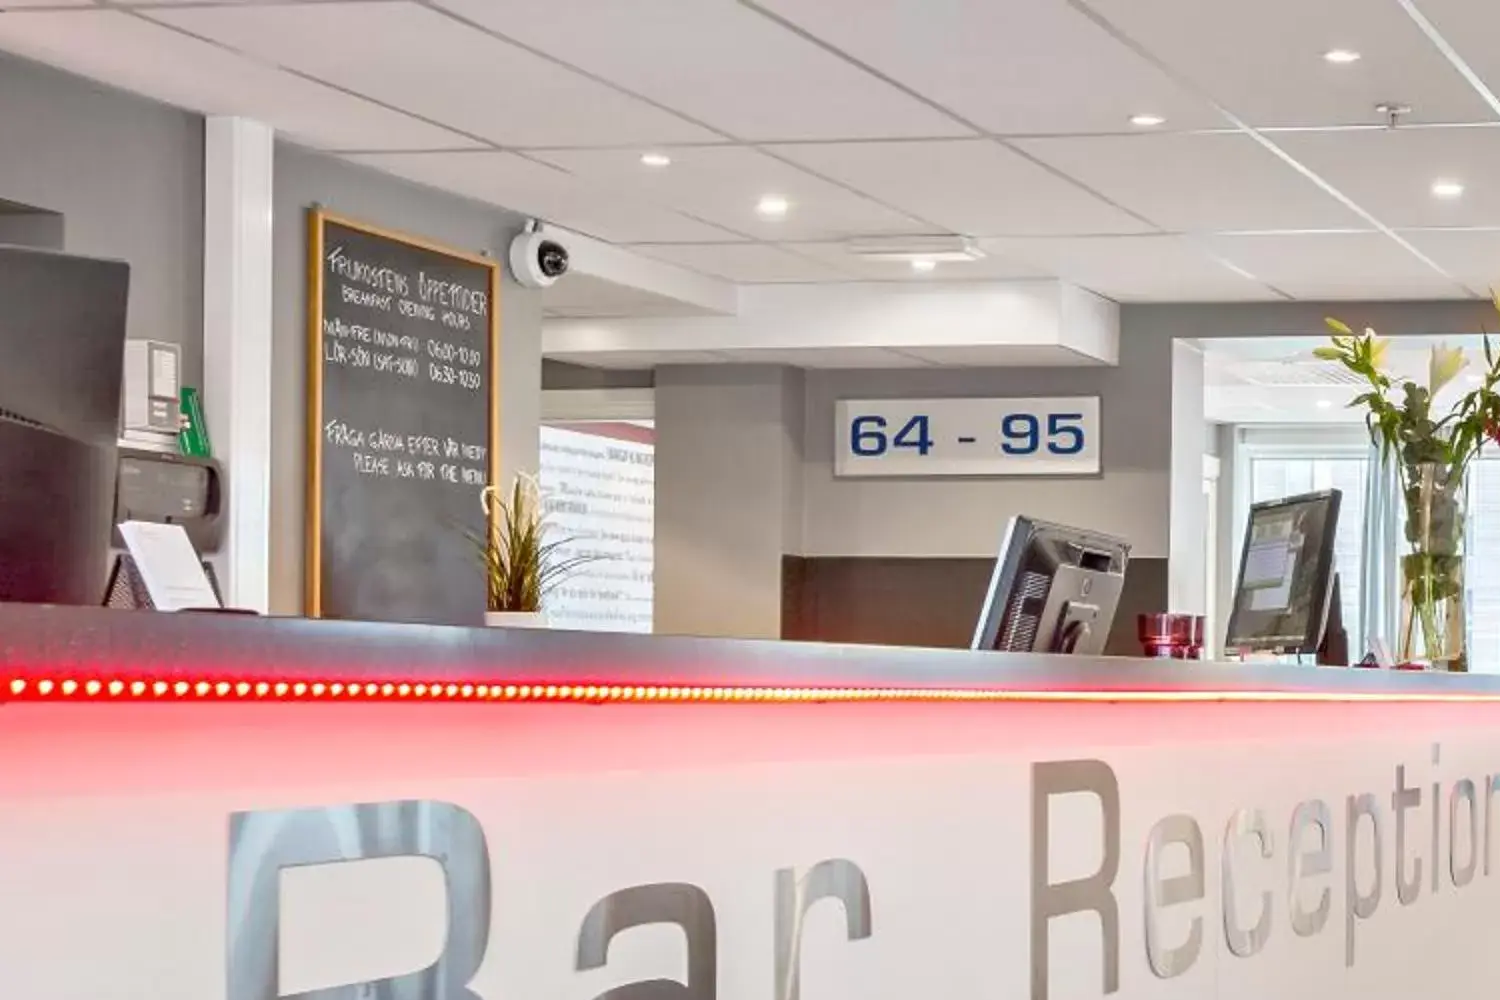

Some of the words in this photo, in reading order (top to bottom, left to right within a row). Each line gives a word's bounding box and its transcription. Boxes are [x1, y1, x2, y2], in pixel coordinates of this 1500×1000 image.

[851, 415, 934, 456] 64
[1001, 413, 1085, 455] 95
[353, 452, 390, 478] PLEASE
